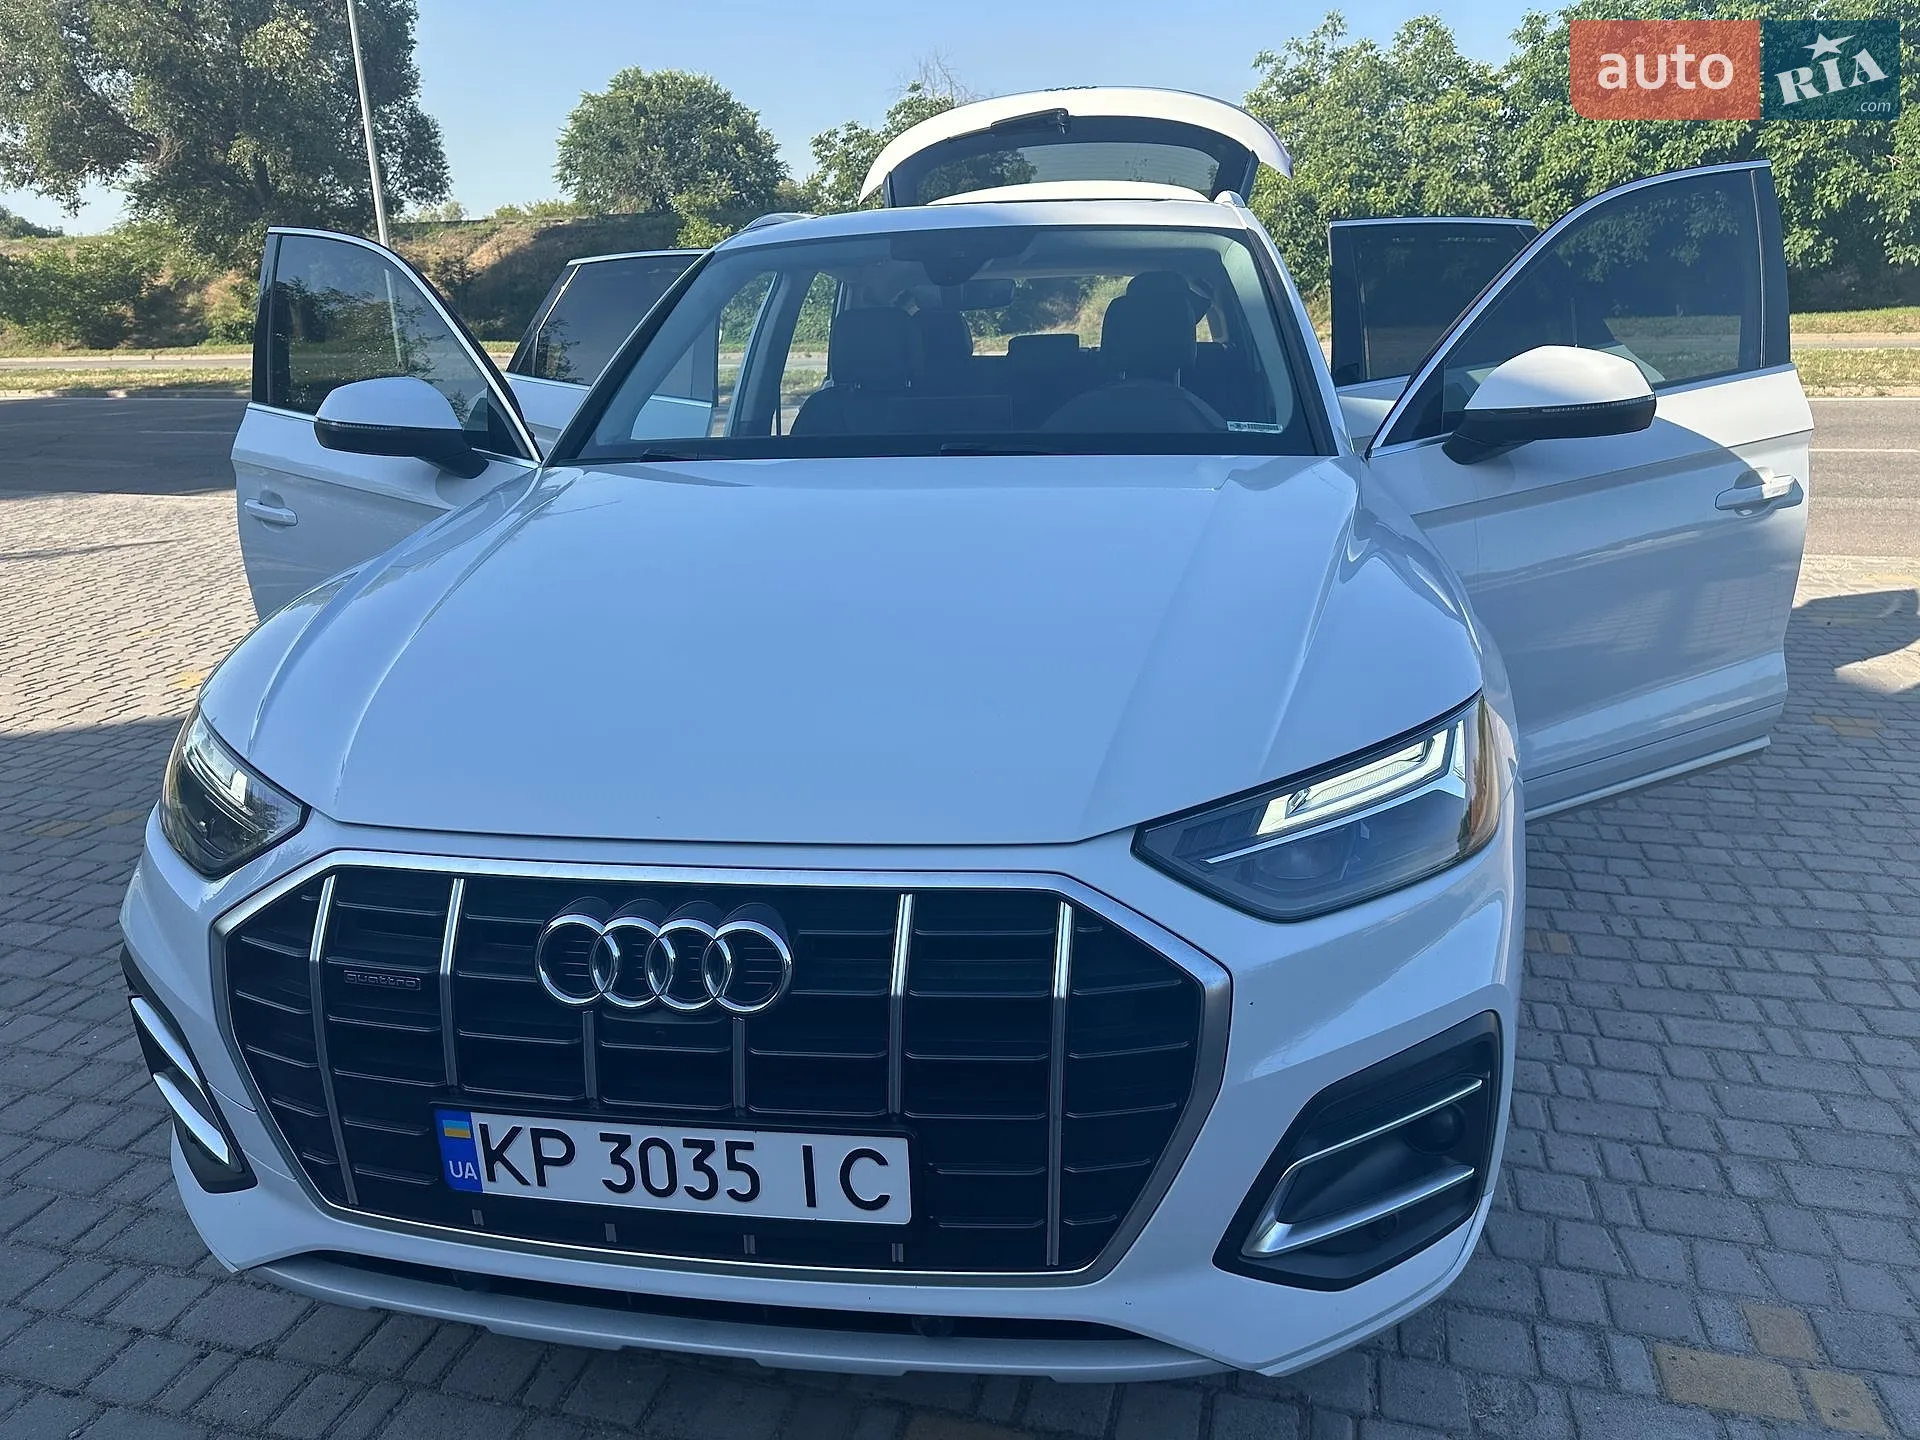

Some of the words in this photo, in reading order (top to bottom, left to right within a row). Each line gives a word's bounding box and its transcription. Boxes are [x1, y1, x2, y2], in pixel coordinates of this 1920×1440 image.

[346, 973, 416, 987] quattro
[450, 1160, 478, 1180] UA
[478, 1122, 576, 1187] KP
[600, 1131, 761, 1202] 3035
